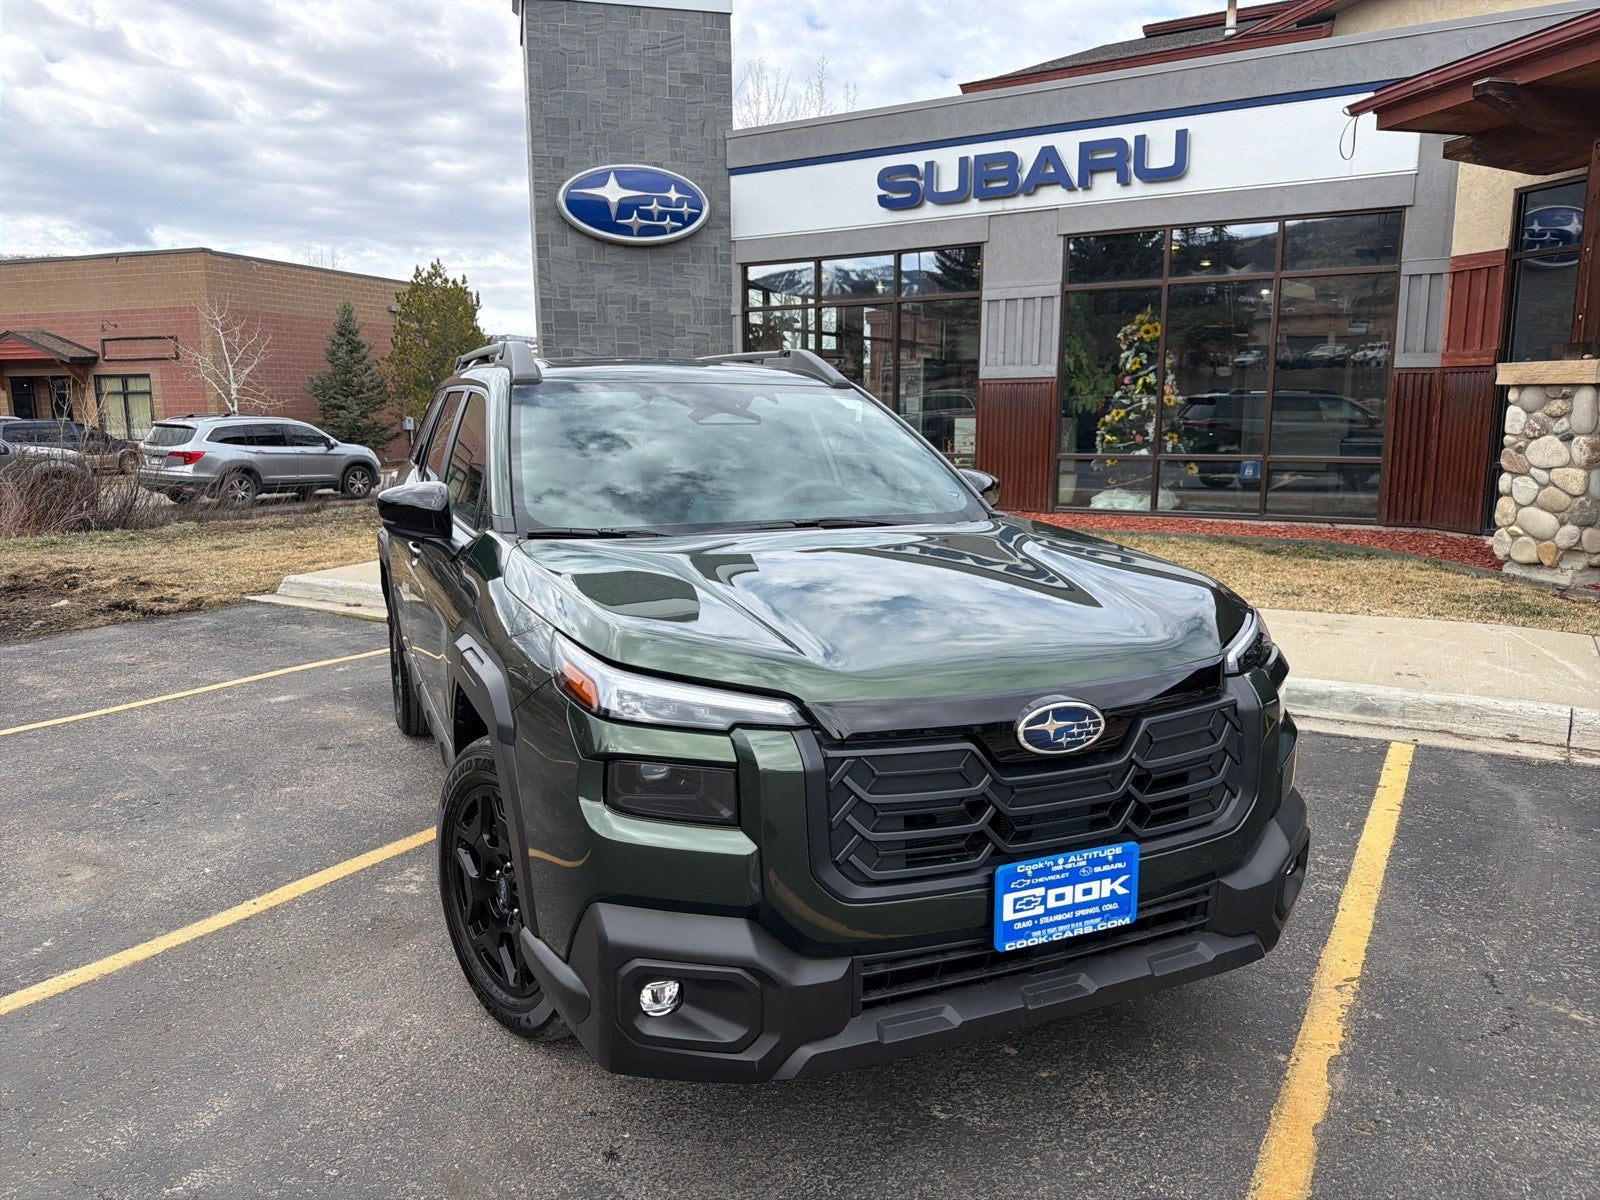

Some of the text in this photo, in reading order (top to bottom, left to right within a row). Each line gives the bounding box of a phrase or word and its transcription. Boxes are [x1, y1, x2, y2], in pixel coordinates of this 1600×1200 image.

[876, 128, 1190, 210] SUBARU
[1017, 860, 1054, 873] Cook'n
[1068, 847, 1122, 862] ALTITUDE
[1093, 861, 1126, 873] SUBARU
[1031, 872, 1069, 884] CHEVROLET
[1013, 919, 1033, 930] CRAIG
[1039, 911, 1074, 925] STEAMBOAT
[1101, 902, 1120, 912] COLO.
